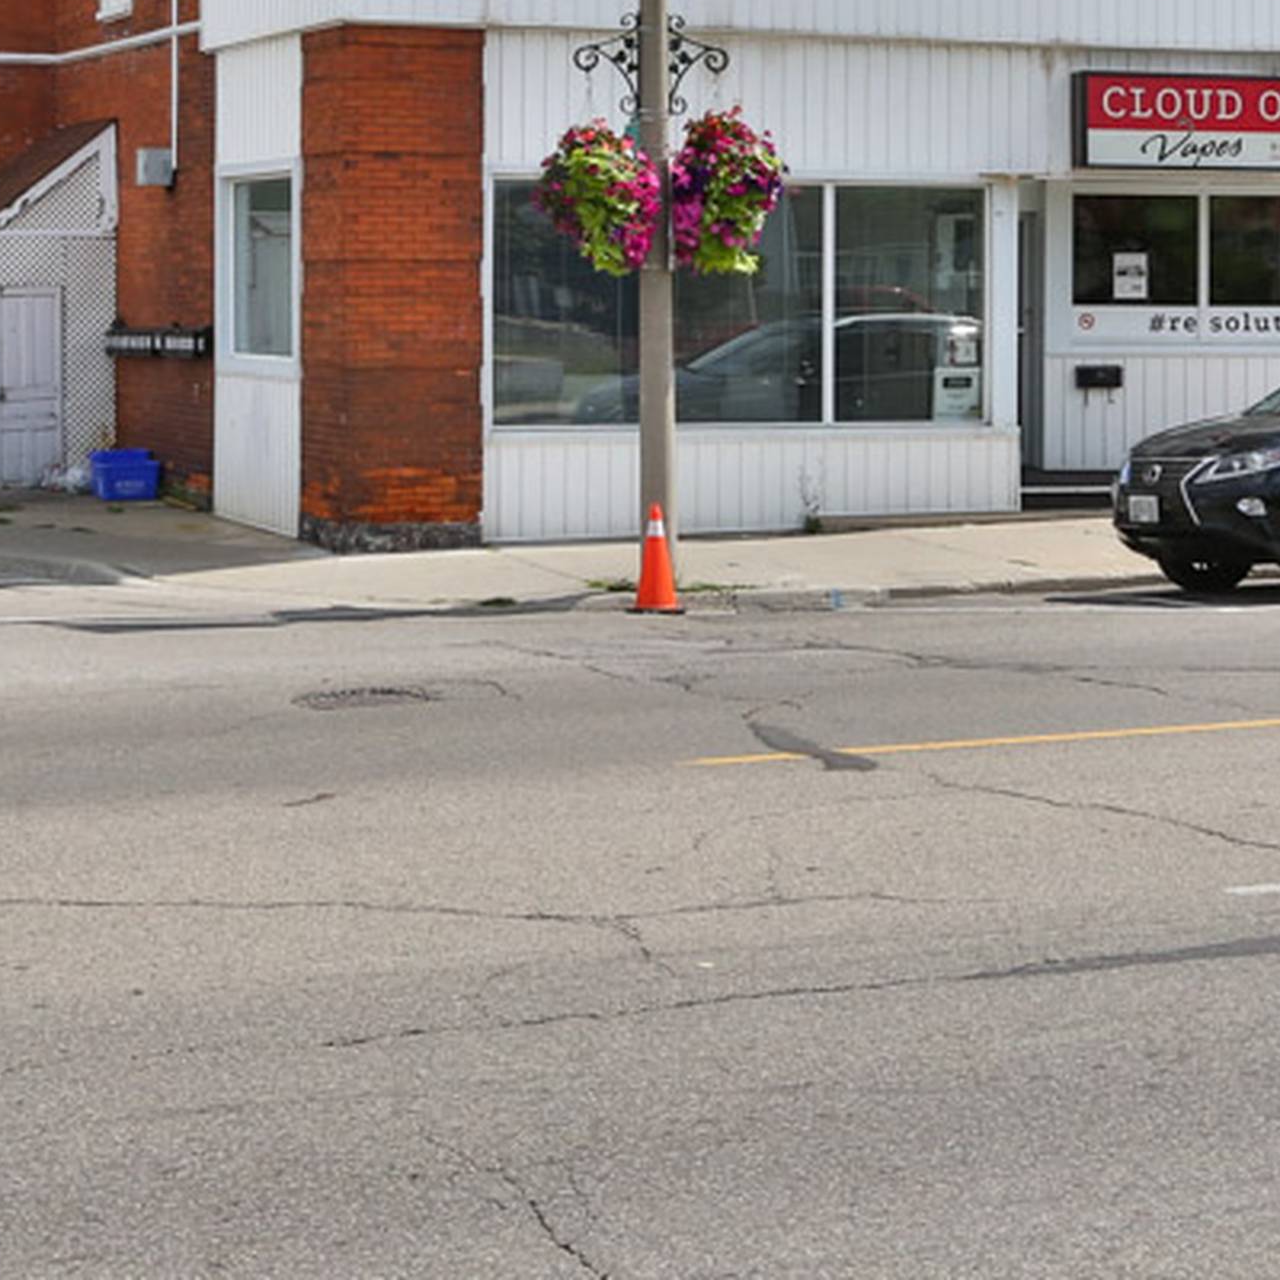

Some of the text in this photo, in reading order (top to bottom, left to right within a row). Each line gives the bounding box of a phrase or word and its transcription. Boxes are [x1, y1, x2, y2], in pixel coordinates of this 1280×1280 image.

[1101, 85, 1243, 120] CLOUD
[1140, 117, 1244, 168] Vapes
[1149, 313, 1198, 333] #re
